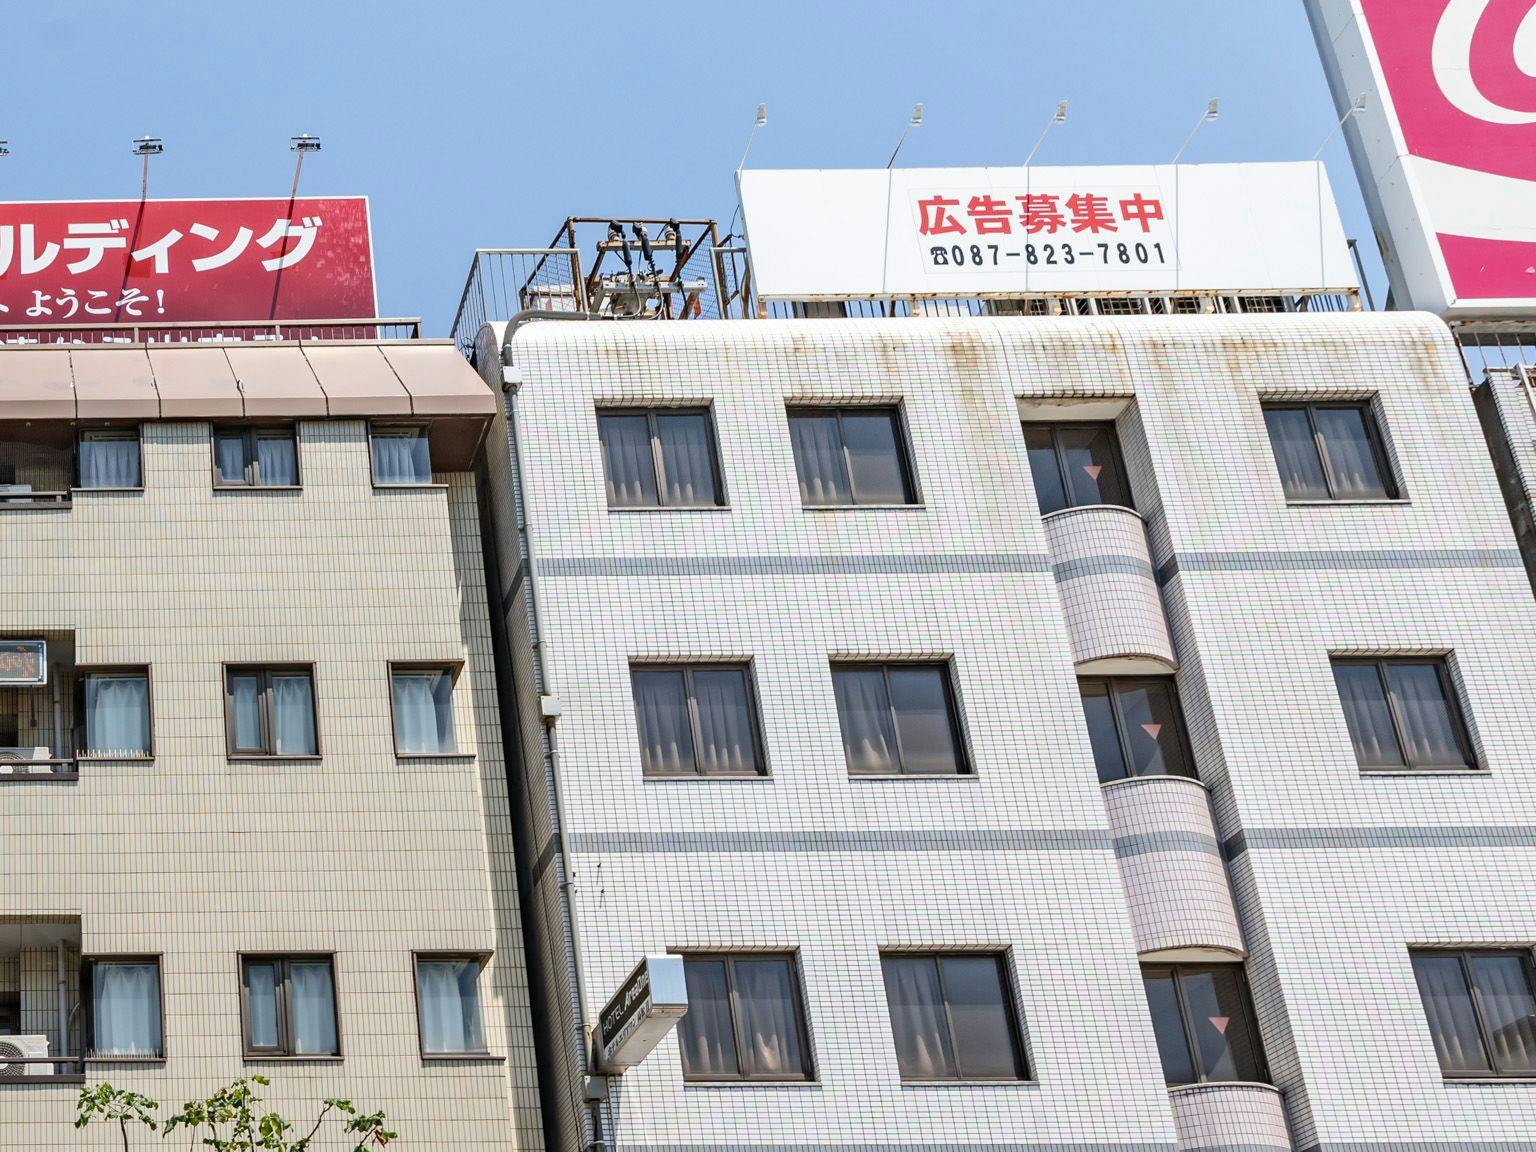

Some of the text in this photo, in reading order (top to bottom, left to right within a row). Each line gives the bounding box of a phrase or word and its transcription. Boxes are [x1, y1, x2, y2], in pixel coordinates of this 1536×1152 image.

[917, 193, 1166, 237] 広告募集中
[952, 242, 1166, 267] 087-823-7801
